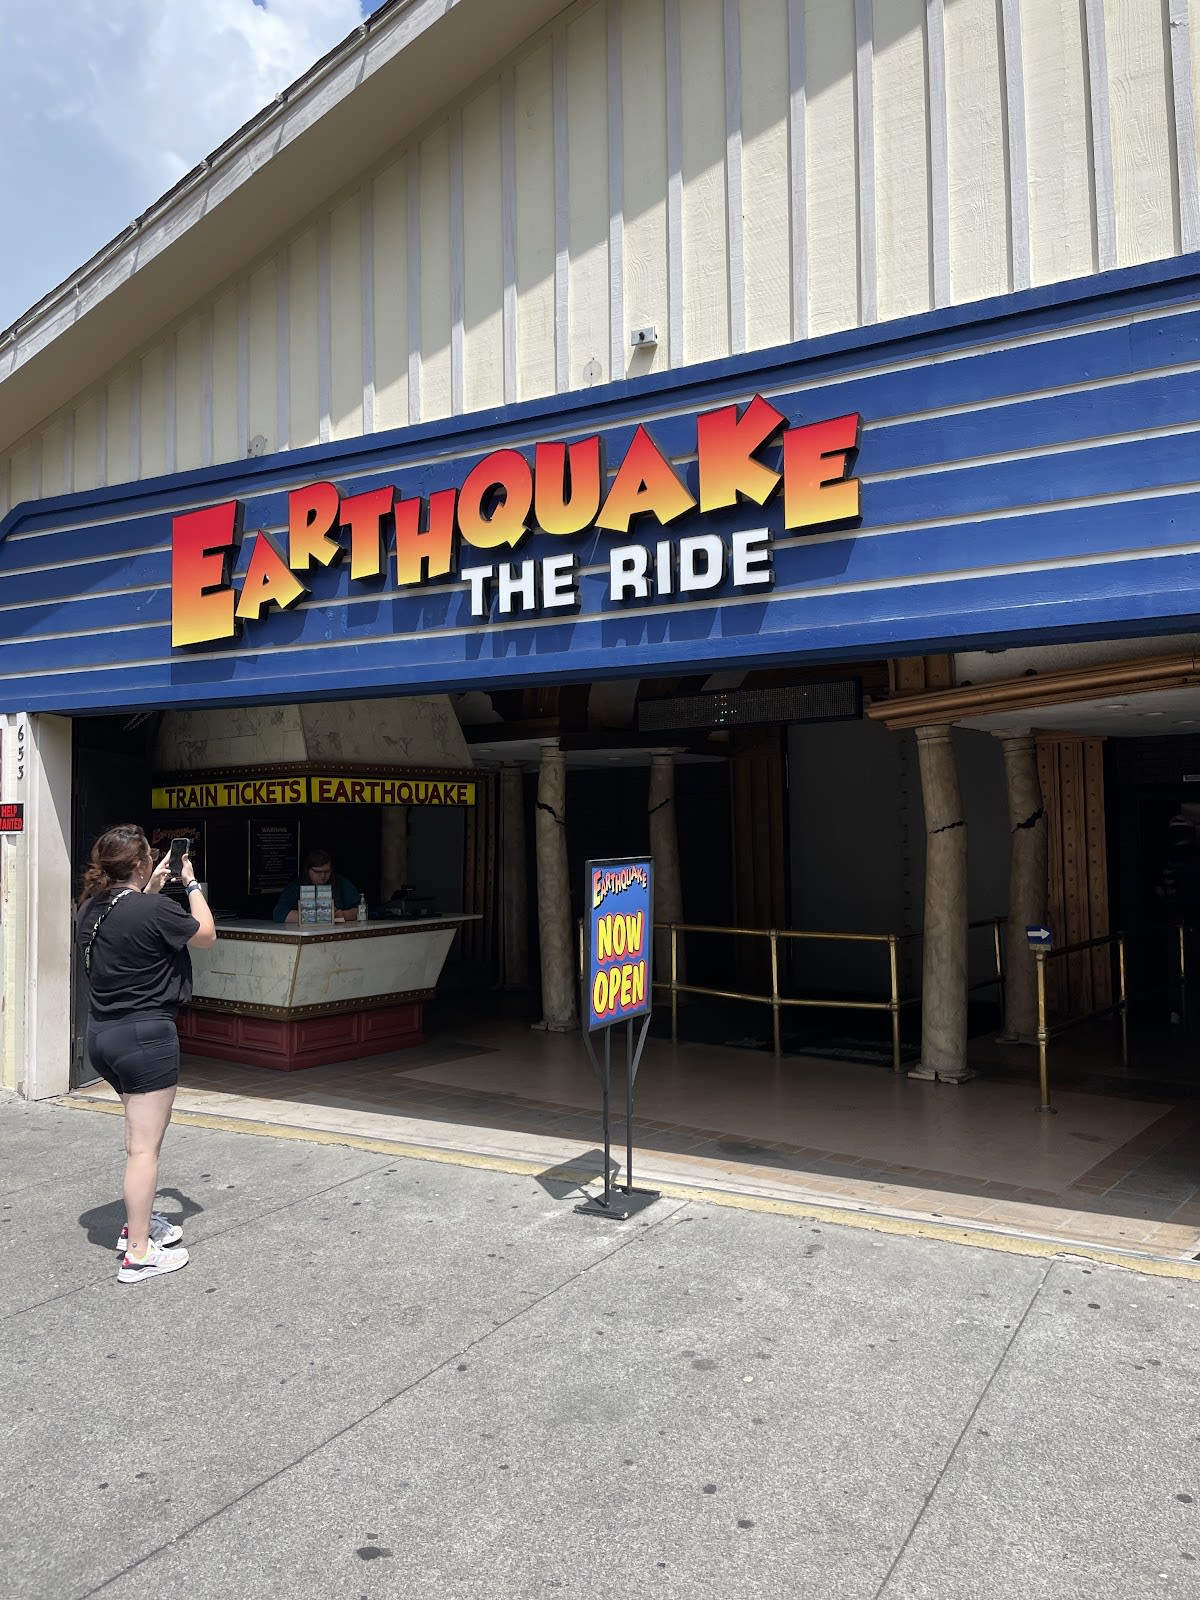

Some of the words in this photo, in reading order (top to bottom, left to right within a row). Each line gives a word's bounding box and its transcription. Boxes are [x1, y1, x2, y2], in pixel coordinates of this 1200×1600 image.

[171, 393, 862, 648] EARTHQUAKE
[461, 555, 578, 618] THE
[609, 526, 776, 603] RIDE
[2, 805, 17, 817] HELP
[165, 786, 218, 808] TRAIN
[223, 780, 302, 805] TICKETS
[318, 780, 468, 805] EARTHQUAKE
[593, 866, 647, 908] EARTHQUAKE
[598, 911, 642, 960] NOW
[593, 960, 644, 1014] OPEN
